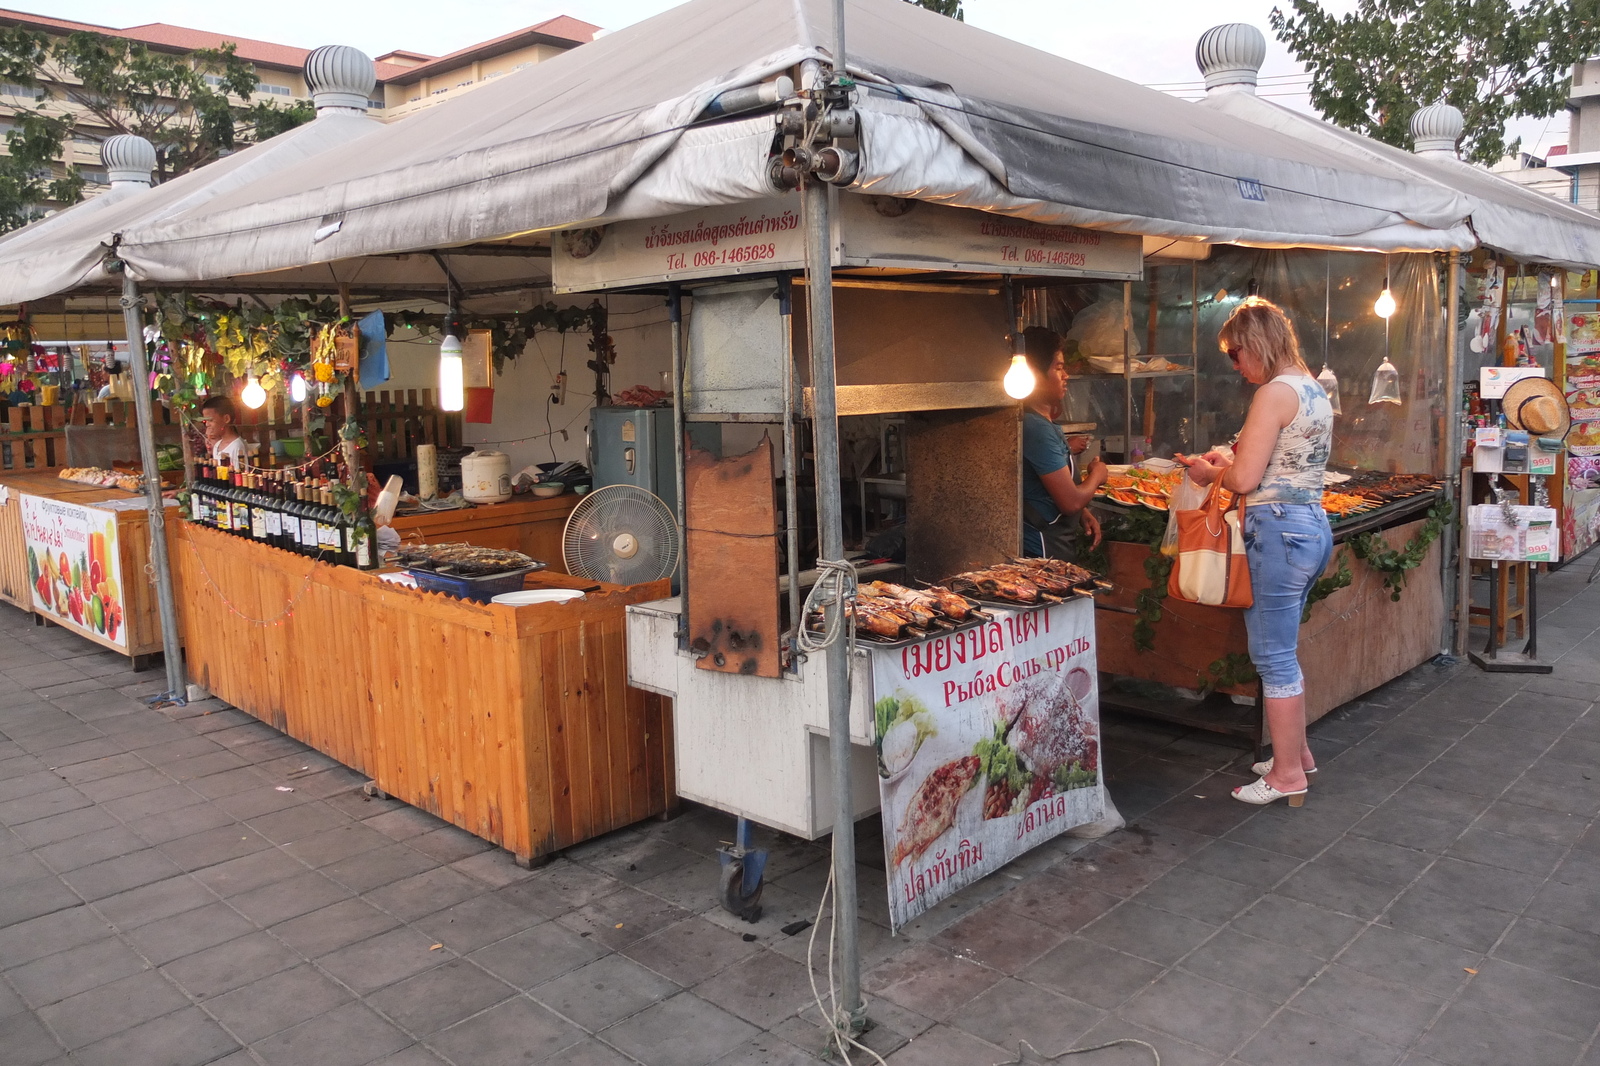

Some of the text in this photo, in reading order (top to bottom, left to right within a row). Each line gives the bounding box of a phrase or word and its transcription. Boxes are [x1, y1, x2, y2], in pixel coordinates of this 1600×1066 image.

[645, 210, 799, 250] น้ำจิ้มรสเด็ดสูตรต้นตำหรับ
[667, 243, 776, 271] Tel. 086-1465628
[1001, 245, 1086, 266] Tel. 086-1465628
[1532, 457, 1551, 467] 999
[63, 525, 86, 543] Smoothies
[1528, 544, 1548, 553] 999
[904, 838, 983, 903] ปลาทับทิม
